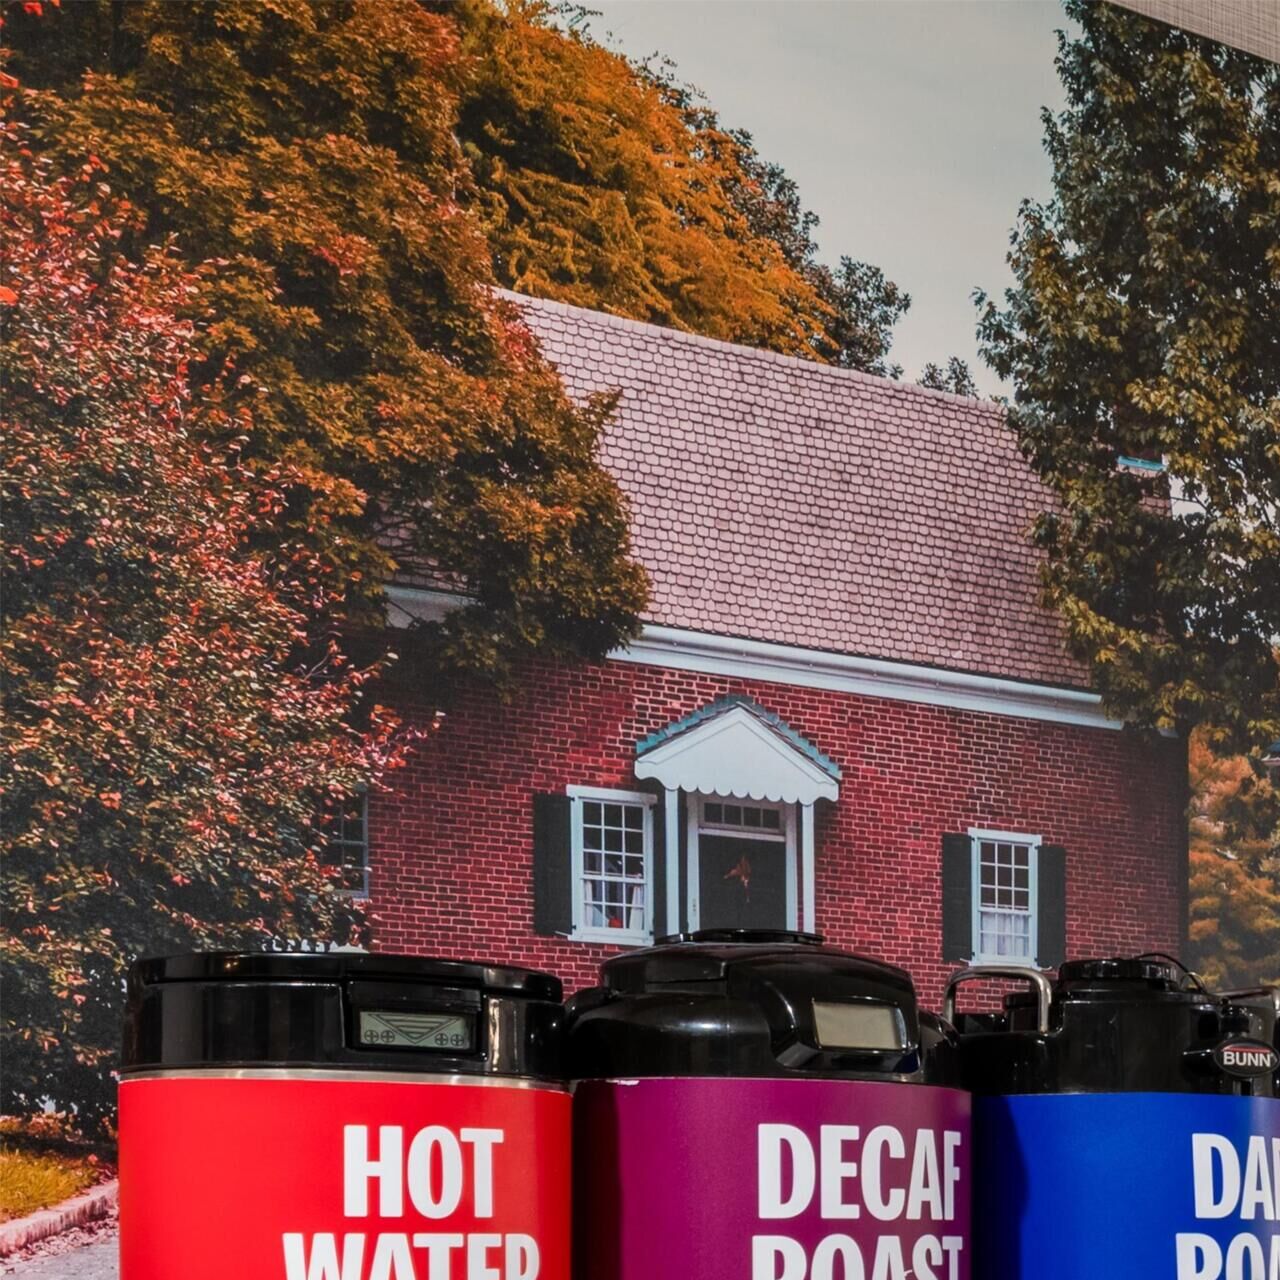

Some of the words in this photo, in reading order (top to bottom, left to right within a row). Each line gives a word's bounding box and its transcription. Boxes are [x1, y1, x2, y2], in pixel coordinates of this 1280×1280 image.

[1223, 1050, 1271, 1067] BUNN
[343, 1124, 504, 1219] HOT
[757, 1123, 961, 1221] DECAF
